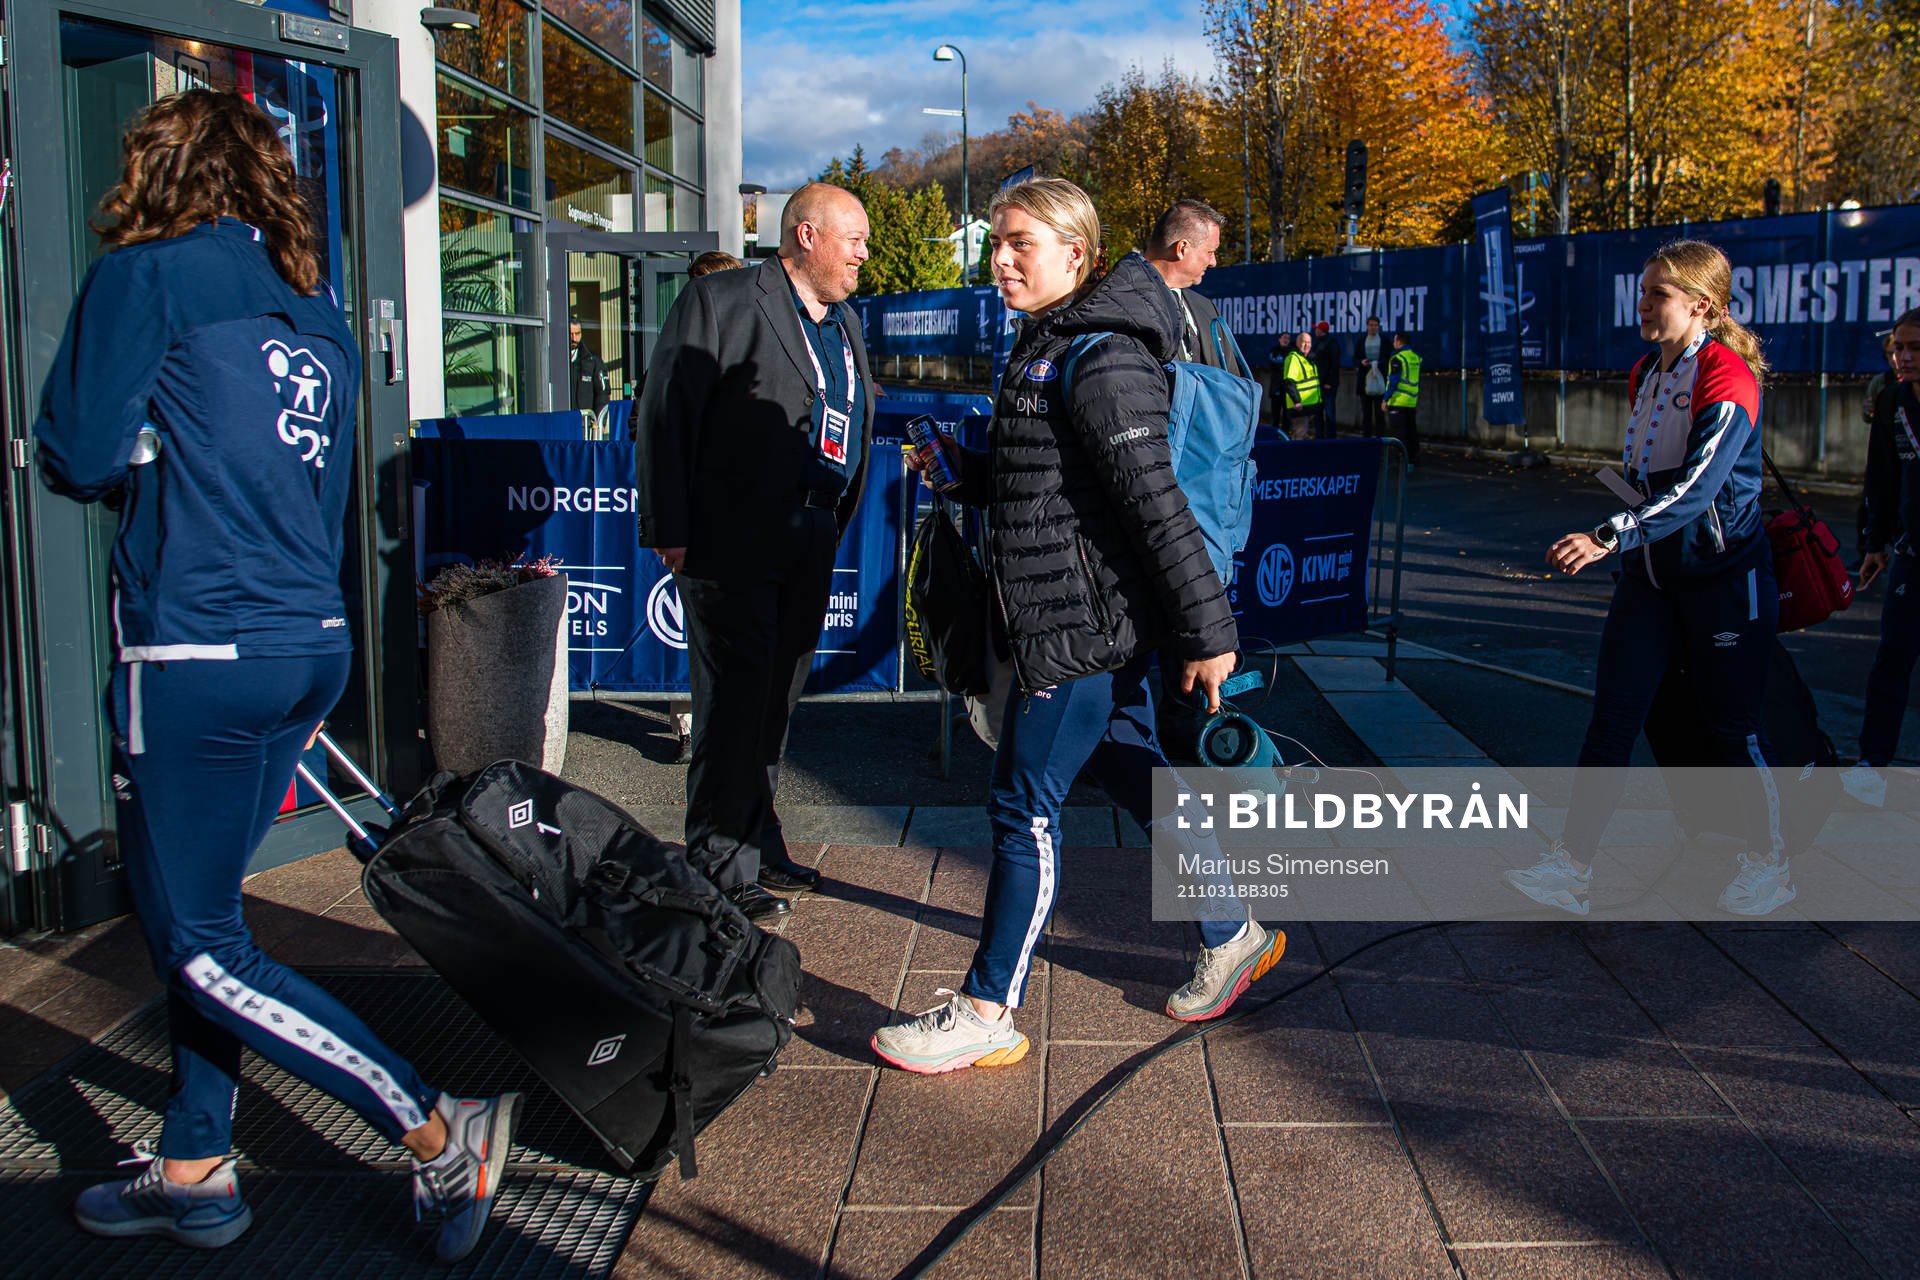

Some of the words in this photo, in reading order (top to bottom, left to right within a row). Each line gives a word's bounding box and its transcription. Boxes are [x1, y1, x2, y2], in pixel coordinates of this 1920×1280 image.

[1016, 394, 1048, 416] DNB
[1109, 427, 1150, 445] umbro
[1252, 475, 1361, 500] MESTERSKAPET
[1301, 553, 1336, 584] KIWI
[568, 620, 608, 636] ELS
[824, 609, 854, 631] pris
[1034, 690, 1052, 699] bro
